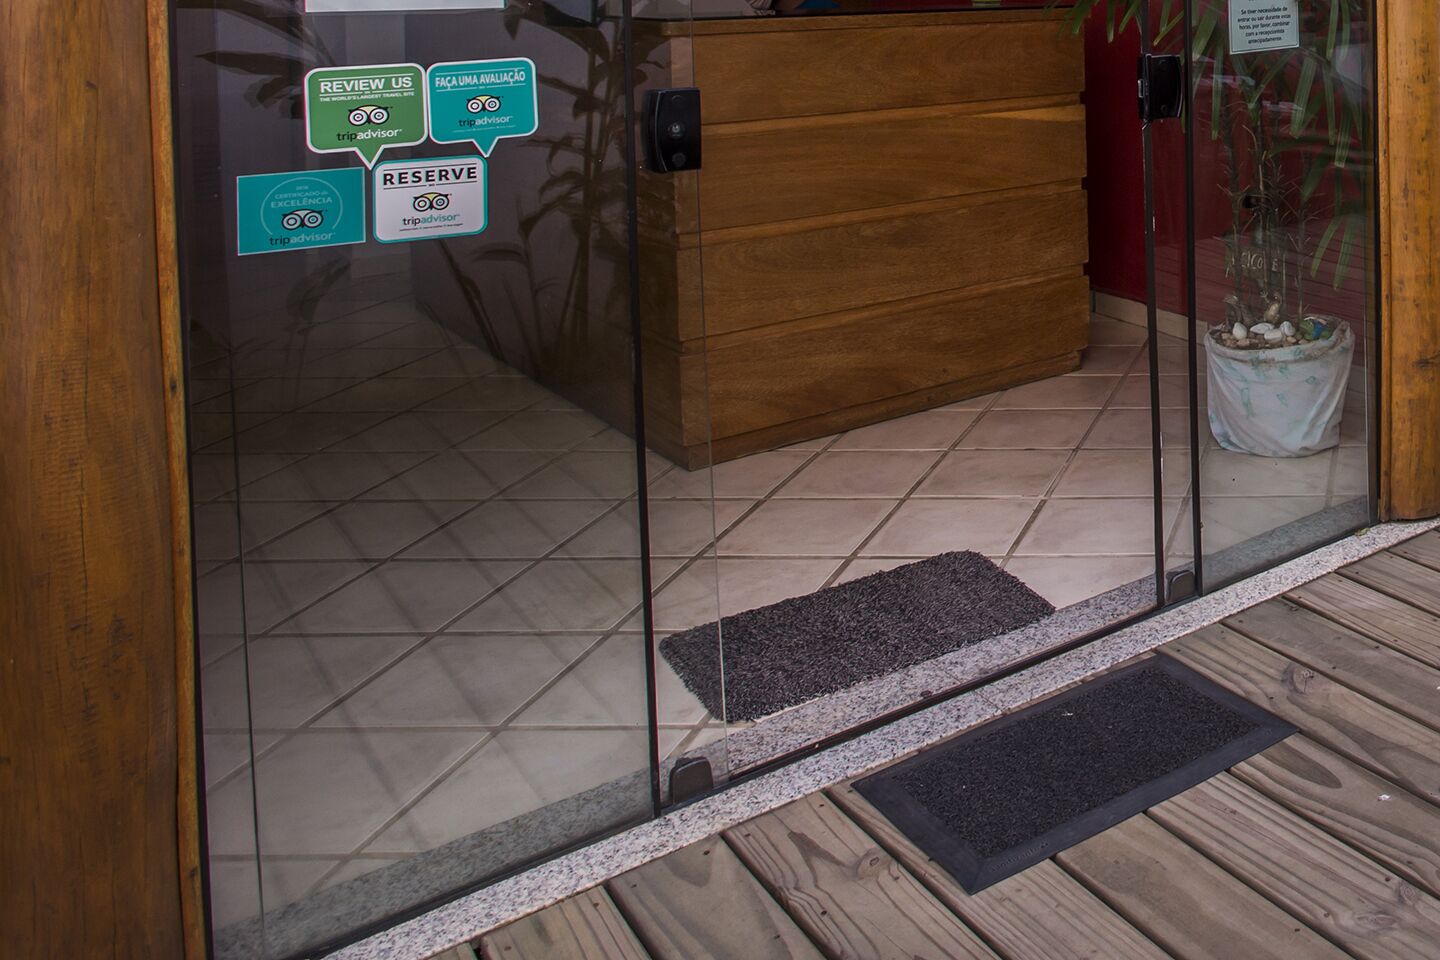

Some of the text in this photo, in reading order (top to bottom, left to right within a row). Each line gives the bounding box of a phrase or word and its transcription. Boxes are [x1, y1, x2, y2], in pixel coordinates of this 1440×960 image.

[320, 77, 413, 93] REVIEW US
[435, 69, 525, 90] FAÇA UMA AVALIAÇÃO
[459, 116, 510, 127] tripadvisor
[337, 129, 399, 142] tripadvisor
[383, 166, 477, 186] RESERVE
[275, 191, 320, 199] CERTIFICADO
[271, 196, 332, 208] EXCELÊNCIA
[402, 214, 458, 226] tripadvisor
[269, 232, 333, 247] tripadvisor
